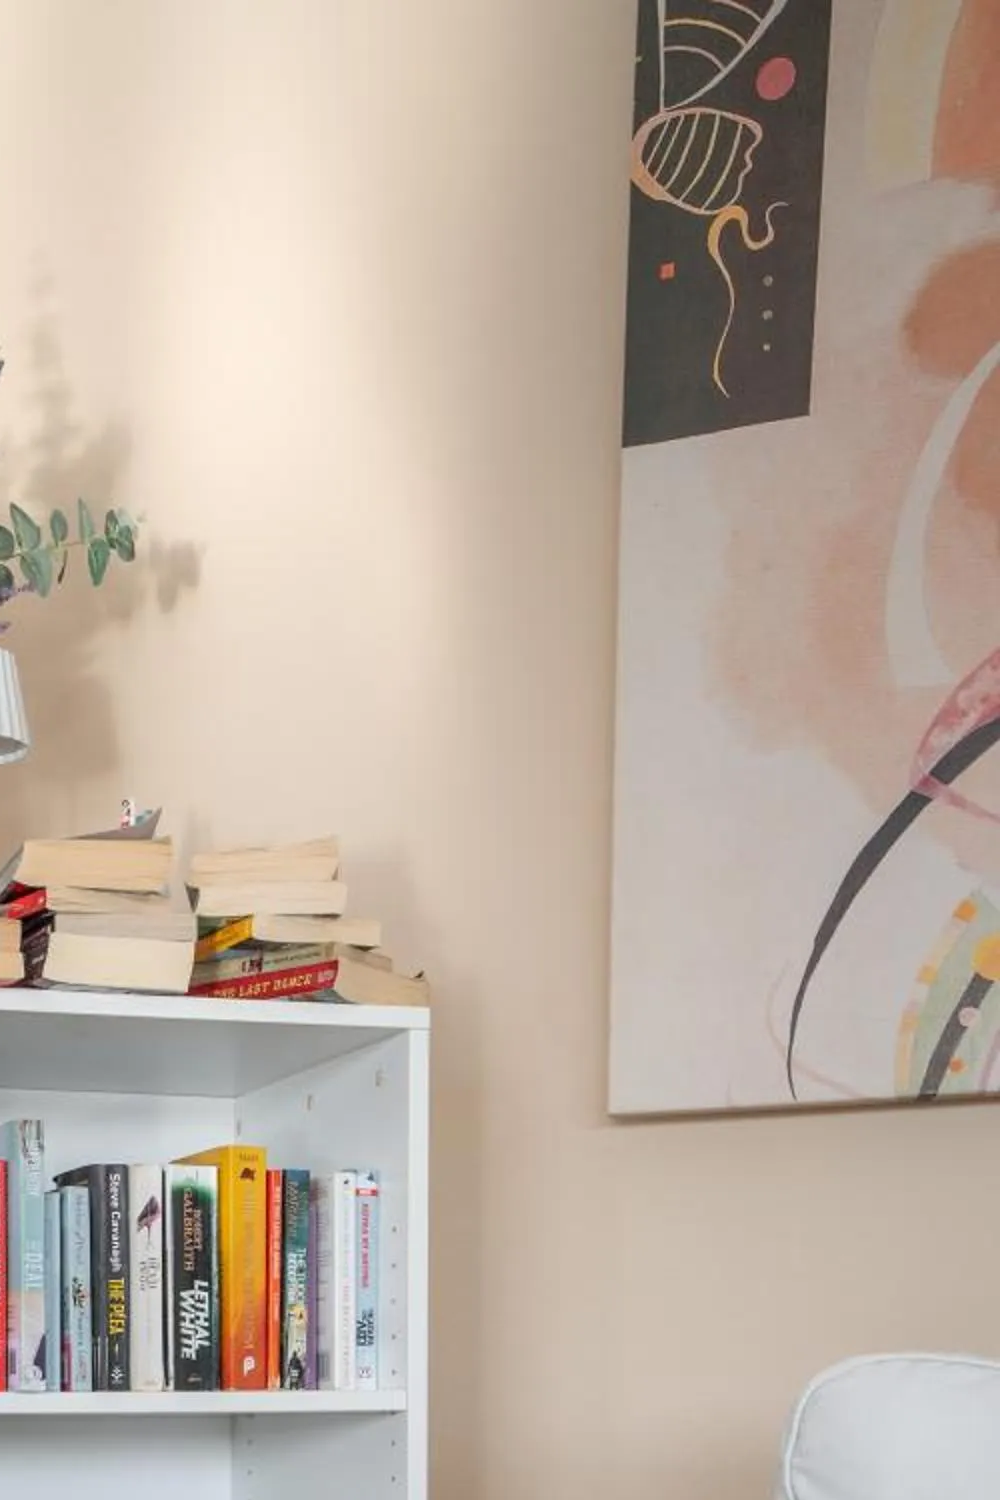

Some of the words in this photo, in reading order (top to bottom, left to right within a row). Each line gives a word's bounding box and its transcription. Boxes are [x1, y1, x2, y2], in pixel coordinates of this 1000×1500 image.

[108, 1173, 121, 1208] Steve
[107, 1211, 122, 1272] Cavanagh
[182, 1189, 194, 1272] GALBRAITH
[24, 1251, 44, 1290] DEAL
[107, 1276, 124, 1303] THE
[107, 1304, 124, 1335] PLEA
[178, 1288, 198, 1361] WHITE
[194, 1279, 211, 1348] LETHAL
